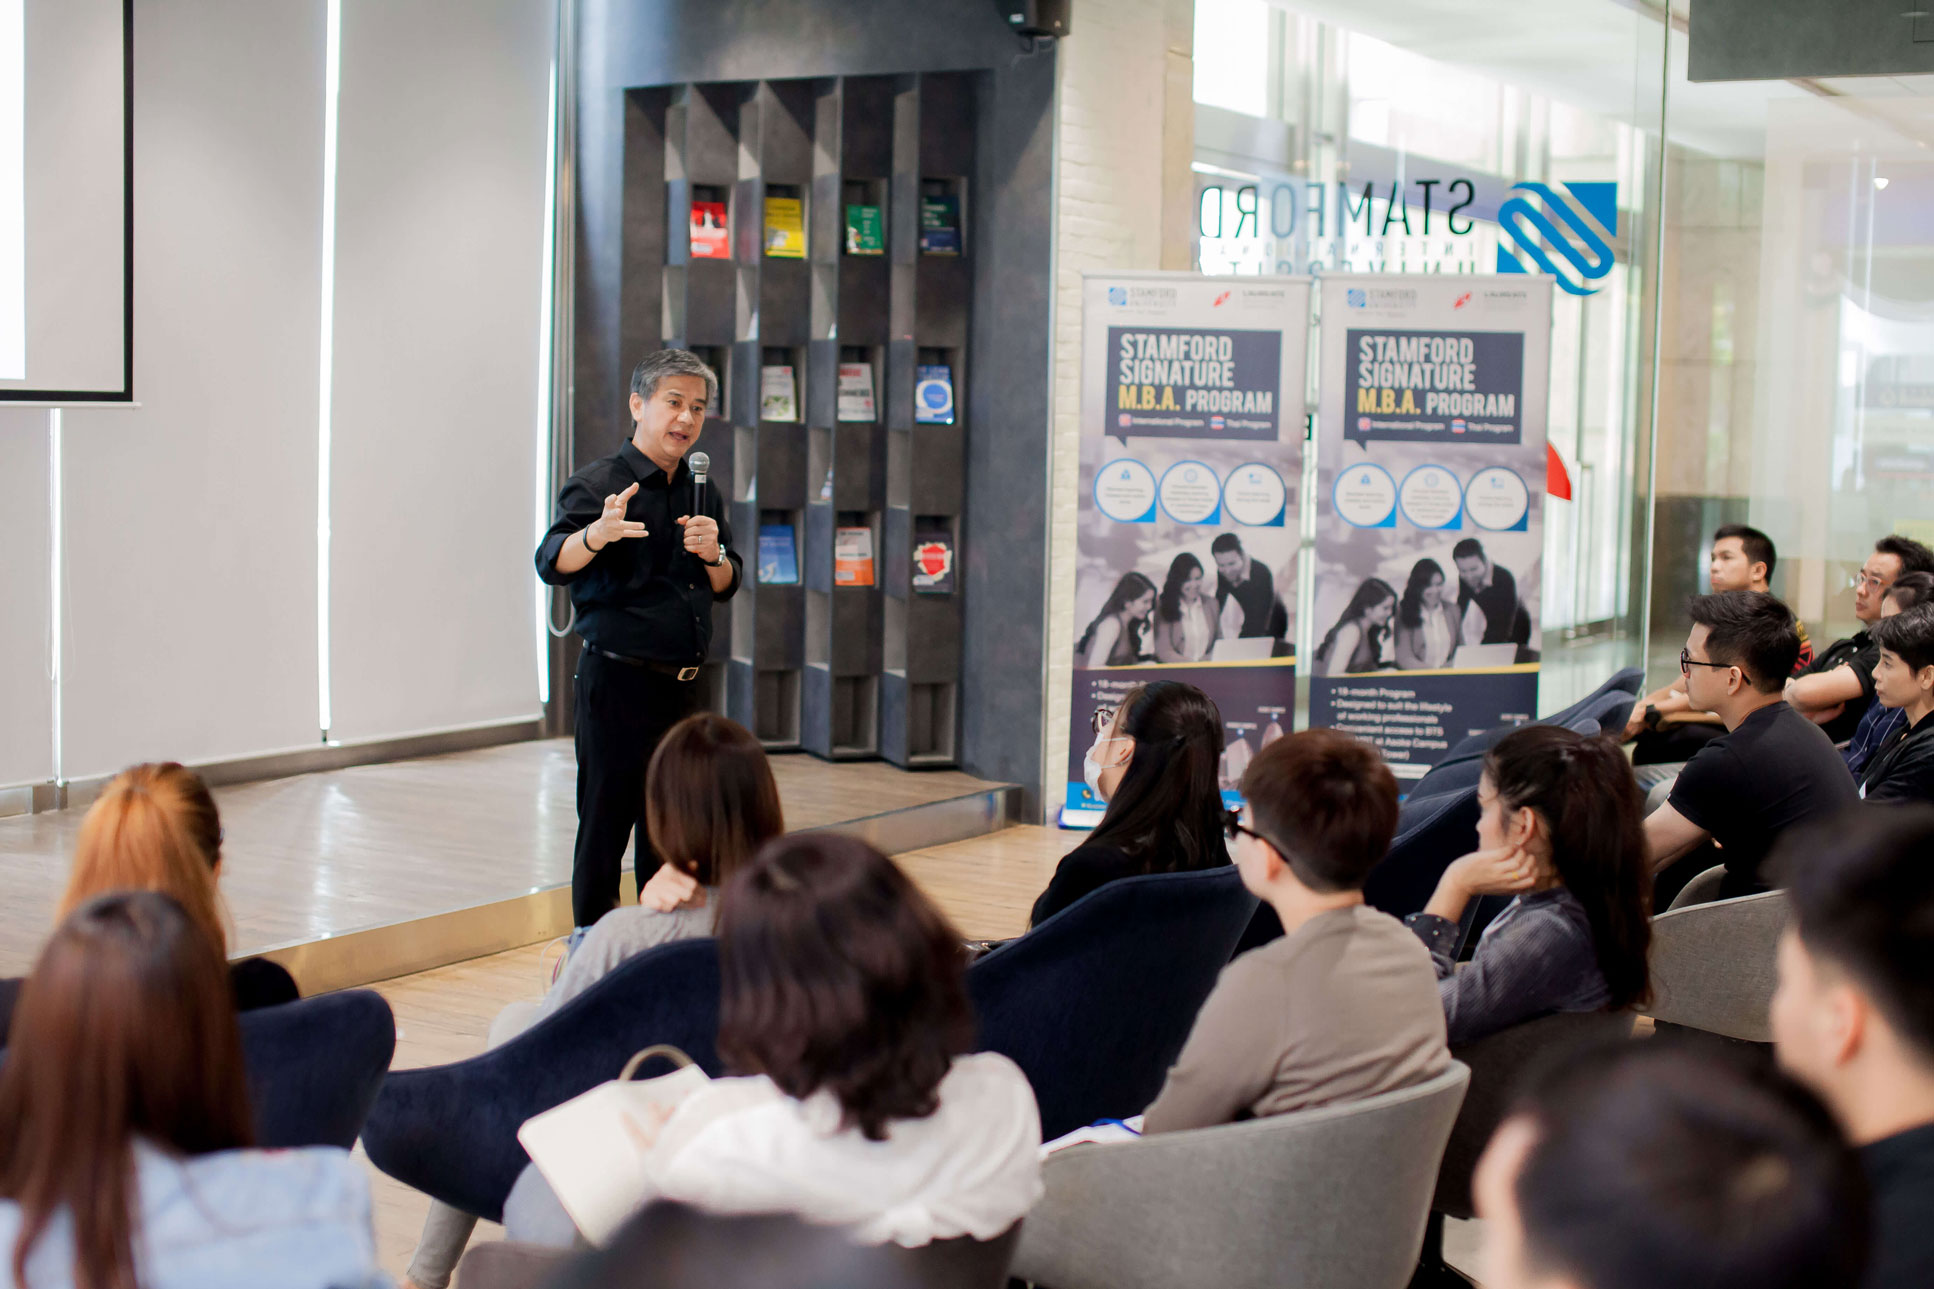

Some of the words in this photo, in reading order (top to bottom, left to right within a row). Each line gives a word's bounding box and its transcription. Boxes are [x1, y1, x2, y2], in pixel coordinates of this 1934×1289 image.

[1120, 333, 1232, 361] STAMFORD
[1359, 335, 1474, 364] STAMFORD
[1119, 359, 1235, 387] SIGNATURE
[1359, 361, 1476, 390] SIGNATURE
[1118, 384, 1181, 411] M.B.A.
[1185, 389, 1272, 414] PROGRAM
[1357, 388, 1421, 415] M.B.A.
[1425, 392, 1514, 417] PROGRAM
[1336, 698, 1376, 710] Designed
[1377, 701, 1386, 709] to
[1387, 701, 1403, 710] suit
[1404, 701, 1419, 710] the
[1419, 702, 1453, 714] lifestyle
[1338, 687, 1378, 697] 18-month
[1379, 687, 1416, 699] Program
[1336, 711, 1347, 720] of
[1348, 712, 1381, 723] working
[1382, 713, 1438, 724] professionals
[1384, 726, 1414, 735] access
[1414, 726, 1424, 736] to
[1425, 726, 1444, 737] BTS
[1413, 738, 1448, 750] Campus
